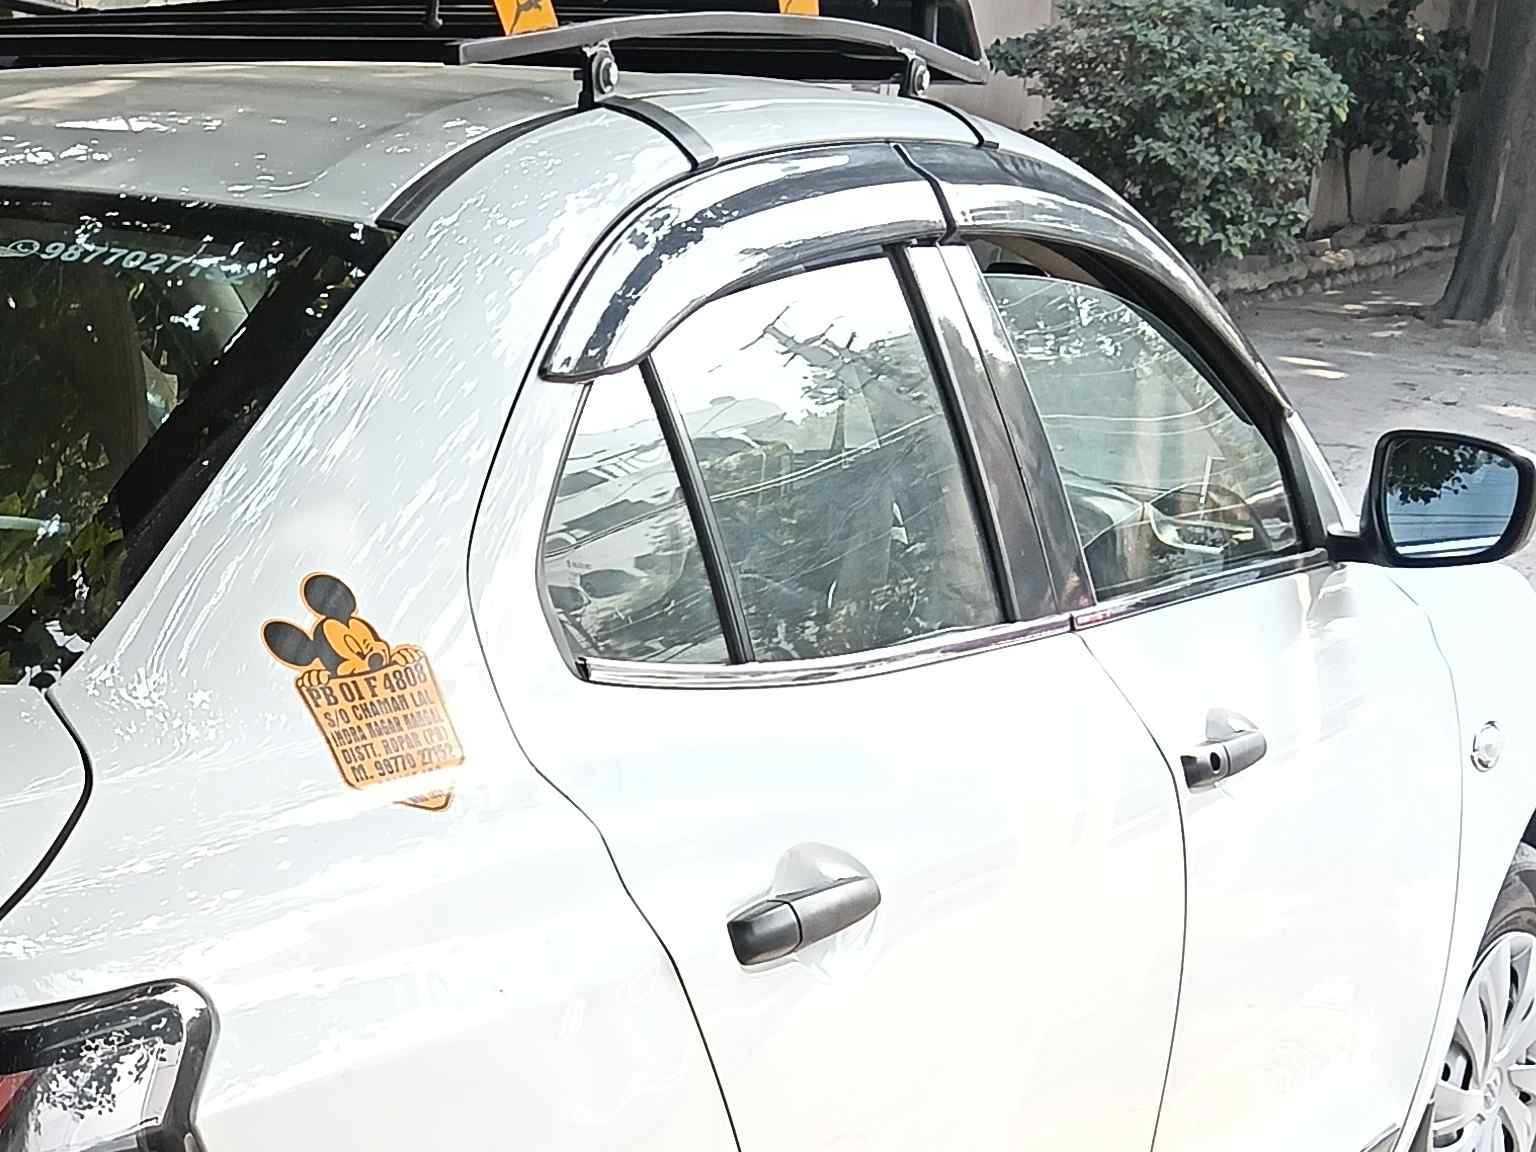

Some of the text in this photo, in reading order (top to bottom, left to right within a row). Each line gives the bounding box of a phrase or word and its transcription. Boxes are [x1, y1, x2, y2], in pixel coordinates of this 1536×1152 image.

[40, 242, 248, 284] 98770271
[306, 685, 339, 708] PB
[364, 676, 379, 698] F
[383, 662, 428, 693] 4808
[323, 689, 434, 728] S/O CHAMAN LAL
[382, 731, 422, 755] ROPAR
[374, 753, 417, 777] 98770
